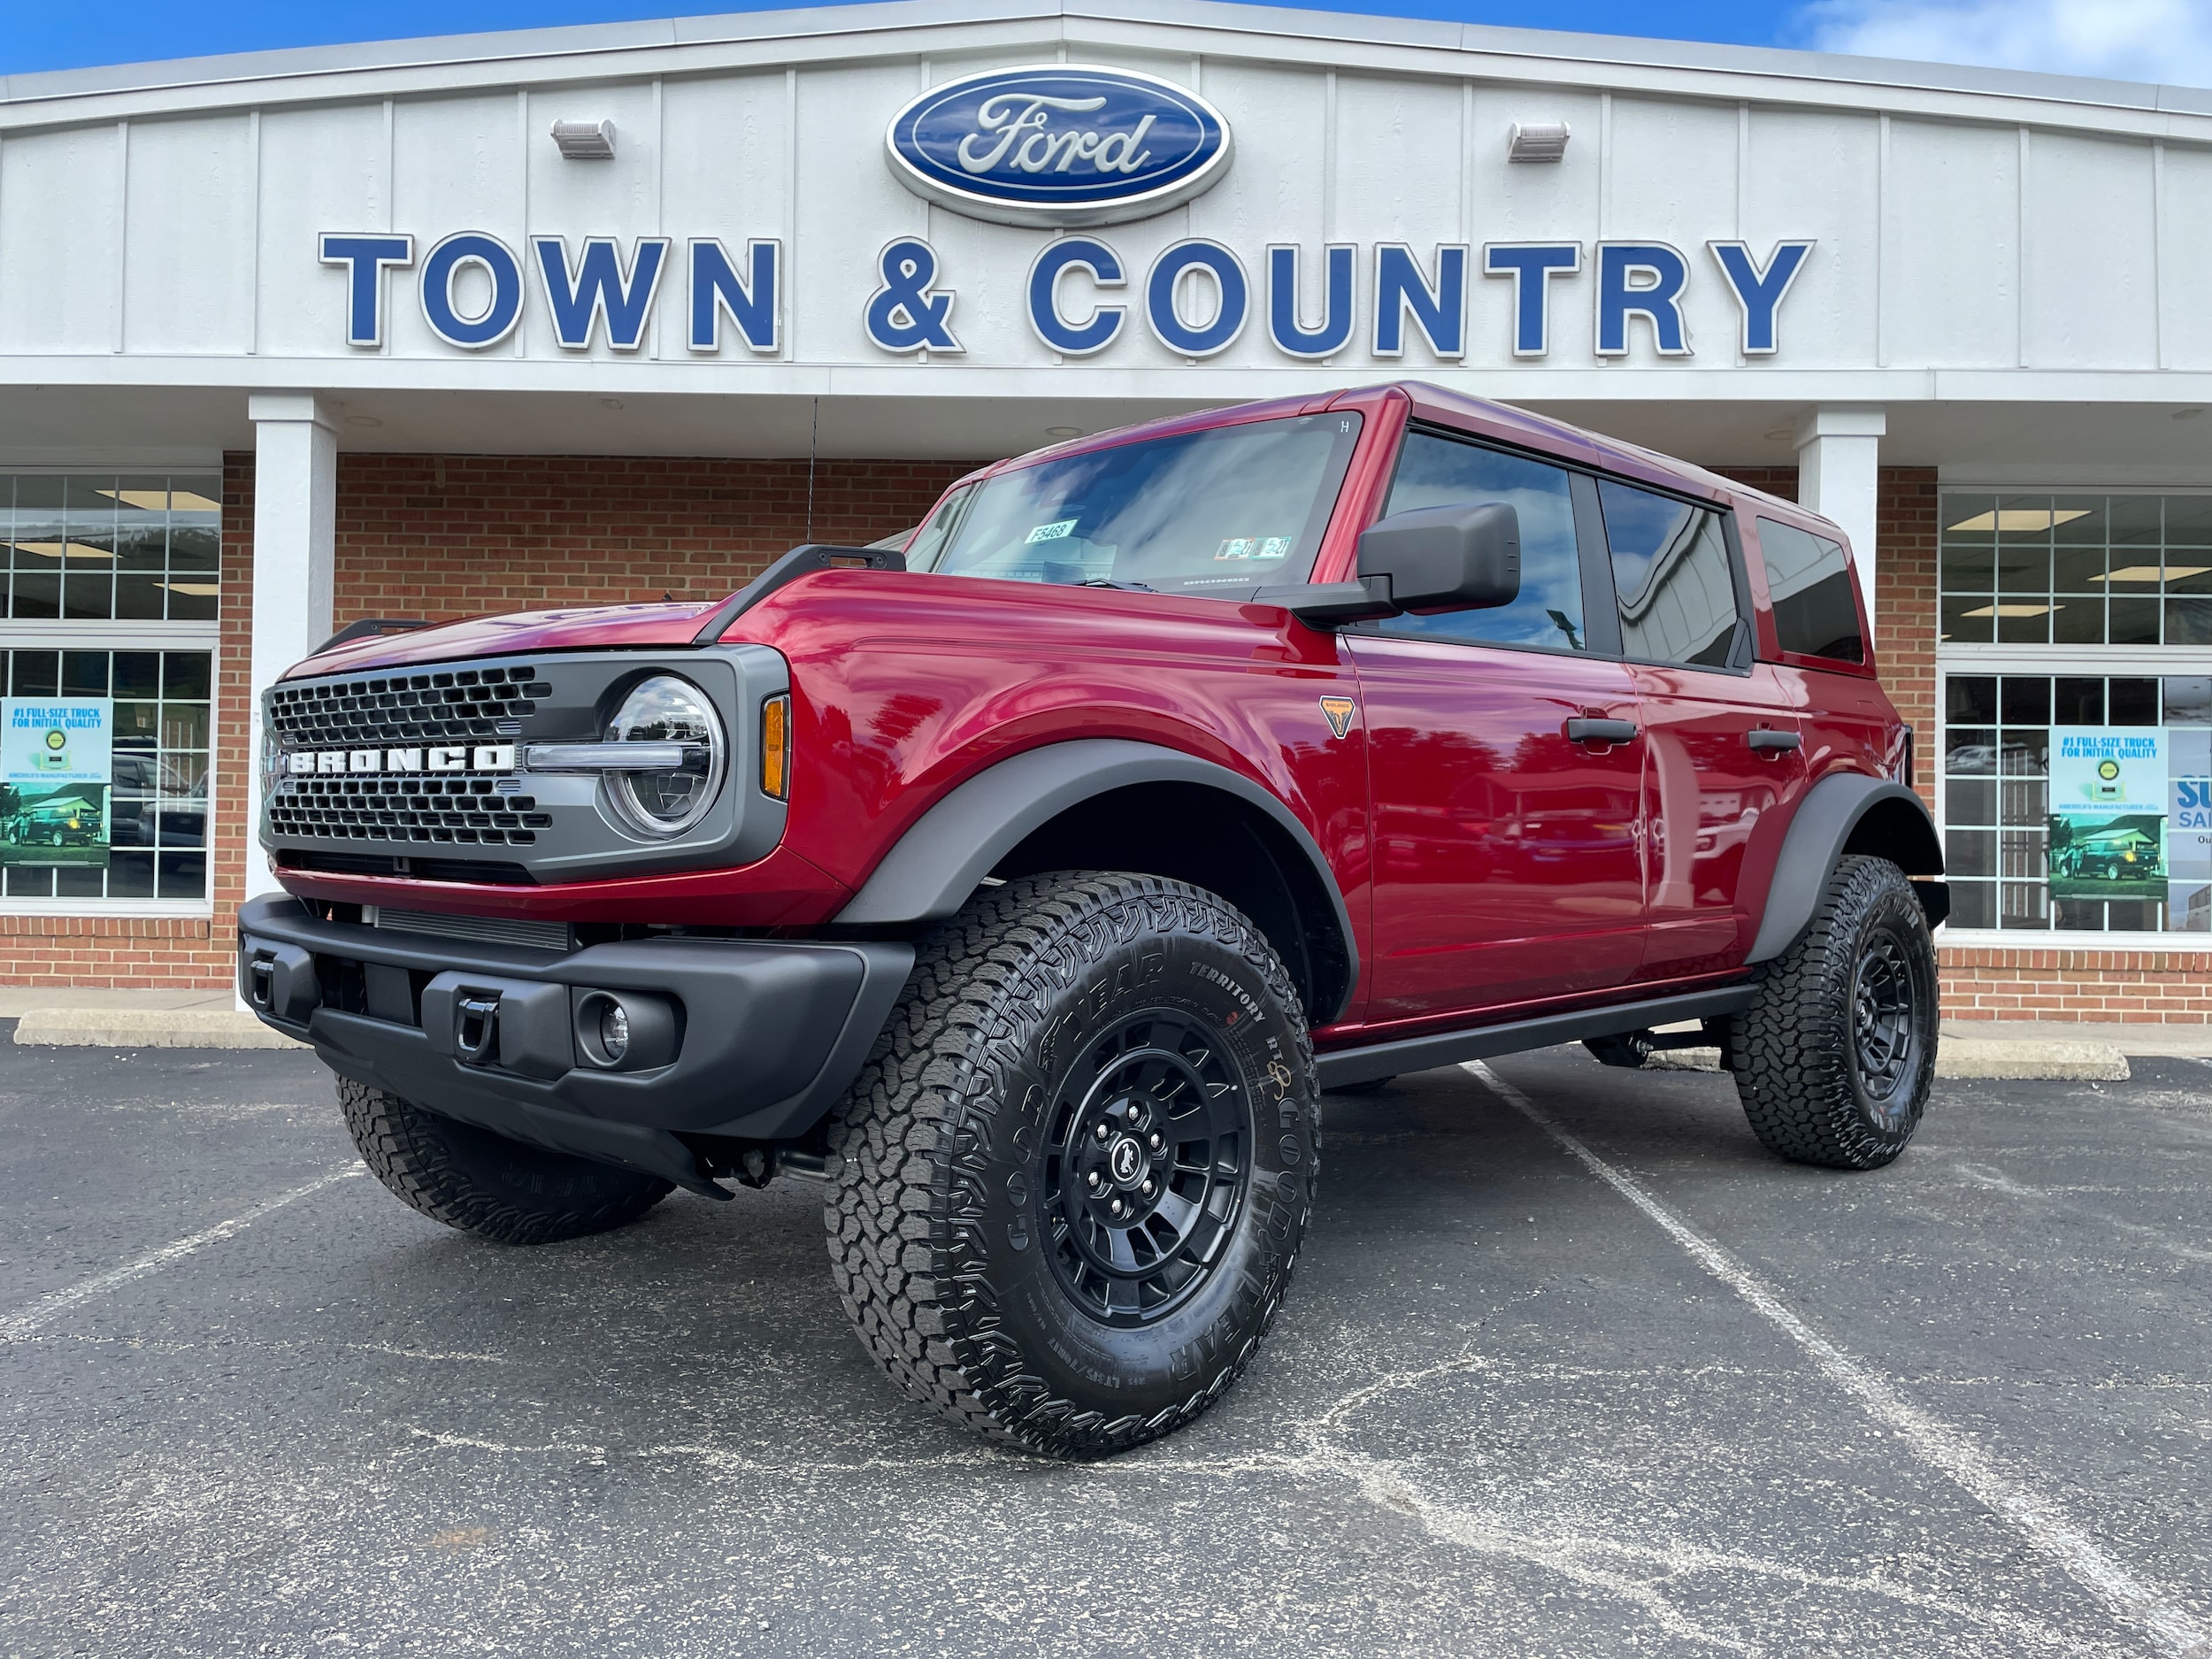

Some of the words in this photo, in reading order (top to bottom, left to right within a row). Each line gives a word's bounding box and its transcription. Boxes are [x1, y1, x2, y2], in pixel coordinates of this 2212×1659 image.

[958, 92, 1156, 174] Ford
[318, 230, 781, 353] TOWN
[863, 235, 967, 354] &
[1024, 234, 1817, 359] COUNTRY
[1340, 420, 1349, 433] H
[1030, 524, 1067, 541] F5468
[14, 708, 25, 718] #1
[27, 708, 68, 718] FULL-SIZE
[71, 708, 100, 718] TRUCK
[12, 718, 29, 728] FOR
[32, 718, 62, 728] INITIAL
[65, 718, 102, 730] QUALITY
[2062, 736, 2075, 747] #1
[2077, 737, 2122, 747] FULL-SIZE
[2124, 737, 2155, 748] TRUCK
[289, 744, 517, 773] BRONCO
[2062, 747, 2080, 757] FOR
[2082, 748, 2115, 757] INITIAL
[2118, 748, 2157, 760] QUALITY
[2179, 811, 2211, 827] SA
[1189, 961, 1267, 1024] TERRITORY
[1265, 1034, 1284, 1061] RT
